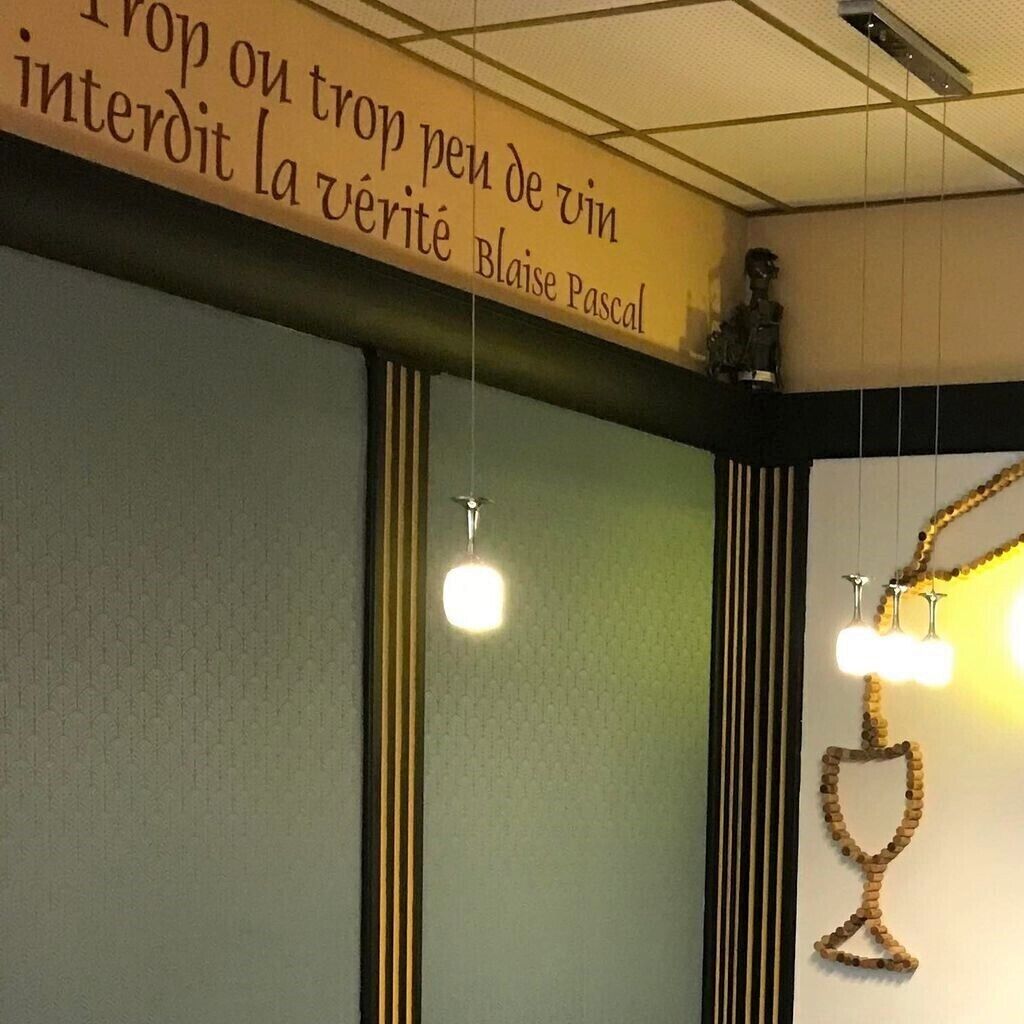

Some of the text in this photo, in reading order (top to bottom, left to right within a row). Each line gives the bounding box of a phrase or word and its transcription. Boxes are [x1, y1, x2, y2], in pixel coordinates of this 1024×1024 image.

[13, 27, 452, 262] interdit la vérité
[229, 40, 292, 104] ou
[309, 64, 405, 171] trop
[419, 122, 492, 188] peu
[505, 142, 543, 213] de
[556, 177, 618, 244] vin
[475, 227, 645, 334] Blaise Pascal
